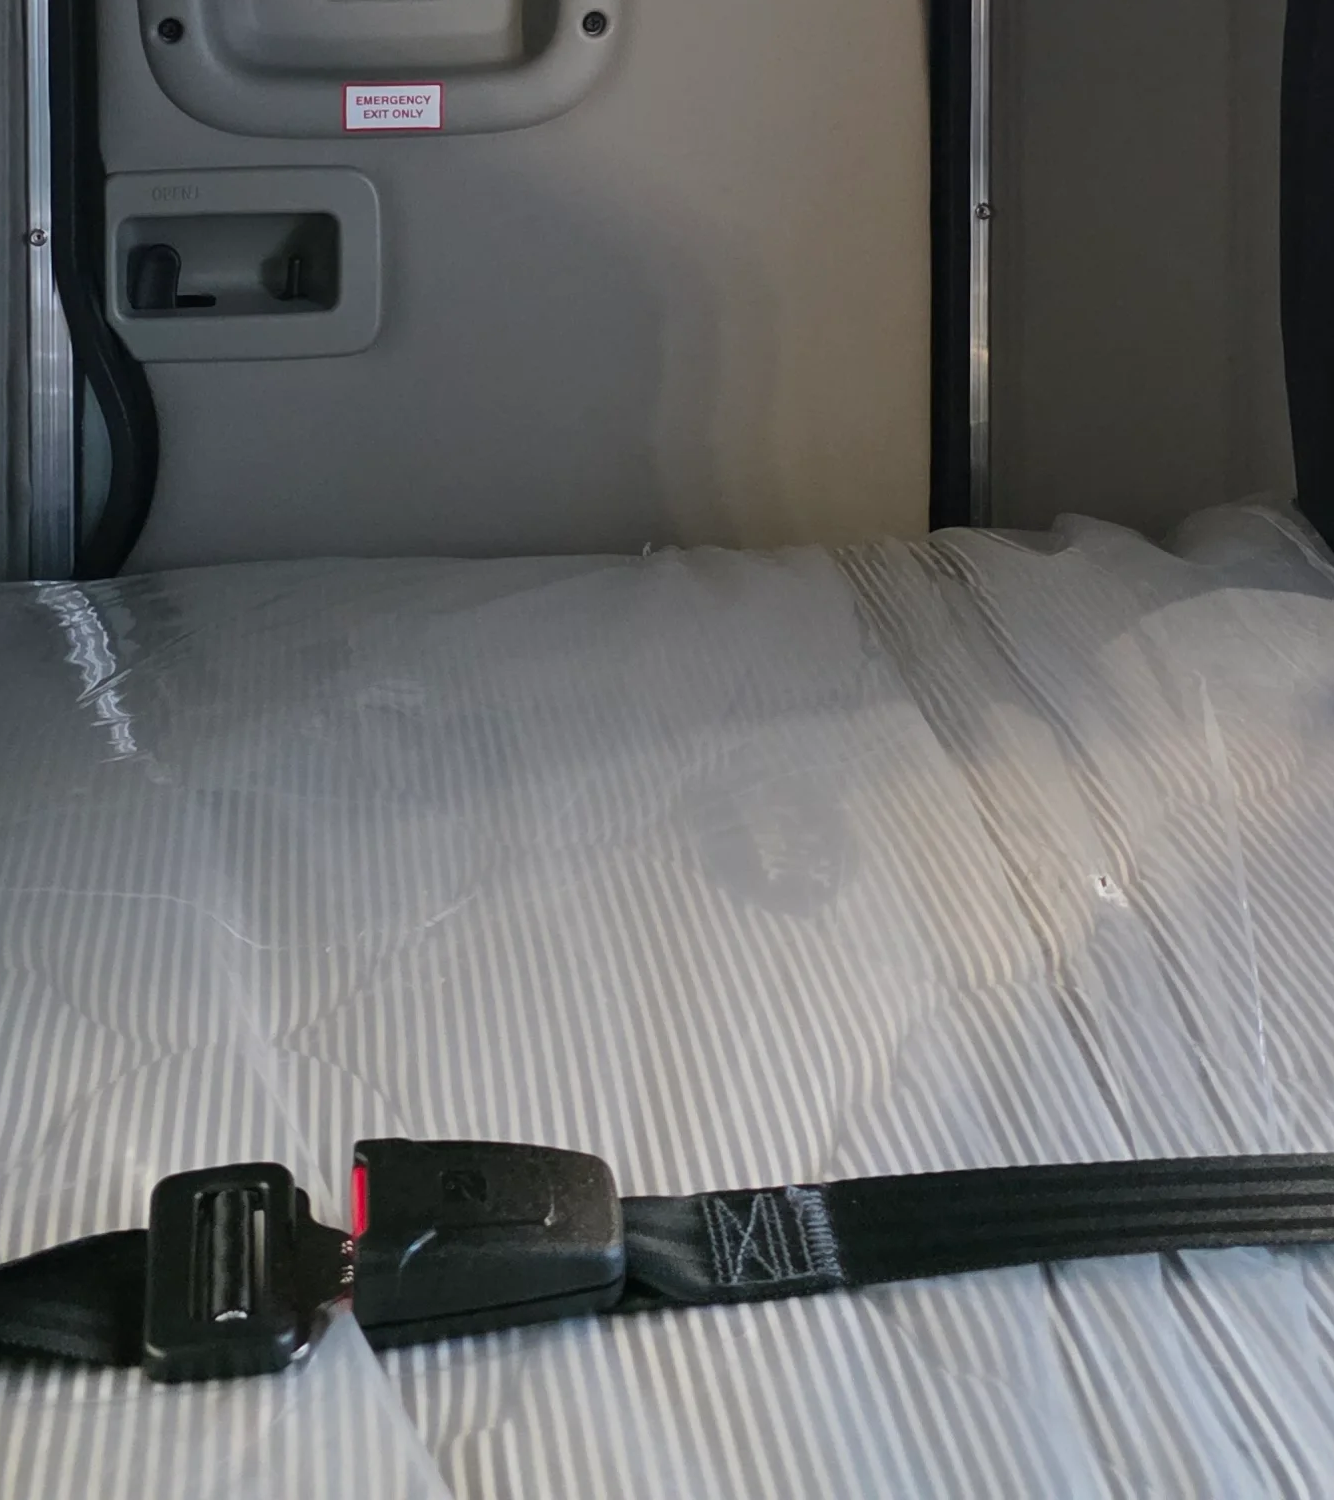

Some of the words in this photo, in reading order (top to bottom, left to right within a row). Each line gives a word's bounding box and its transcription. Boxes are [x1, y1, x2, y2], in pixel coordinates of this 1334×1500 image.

[355, 95, 431, 106] EMERGENCY
[363, 109, 389, 119] EXIT
[392, 109, 424, 119] ONLY
